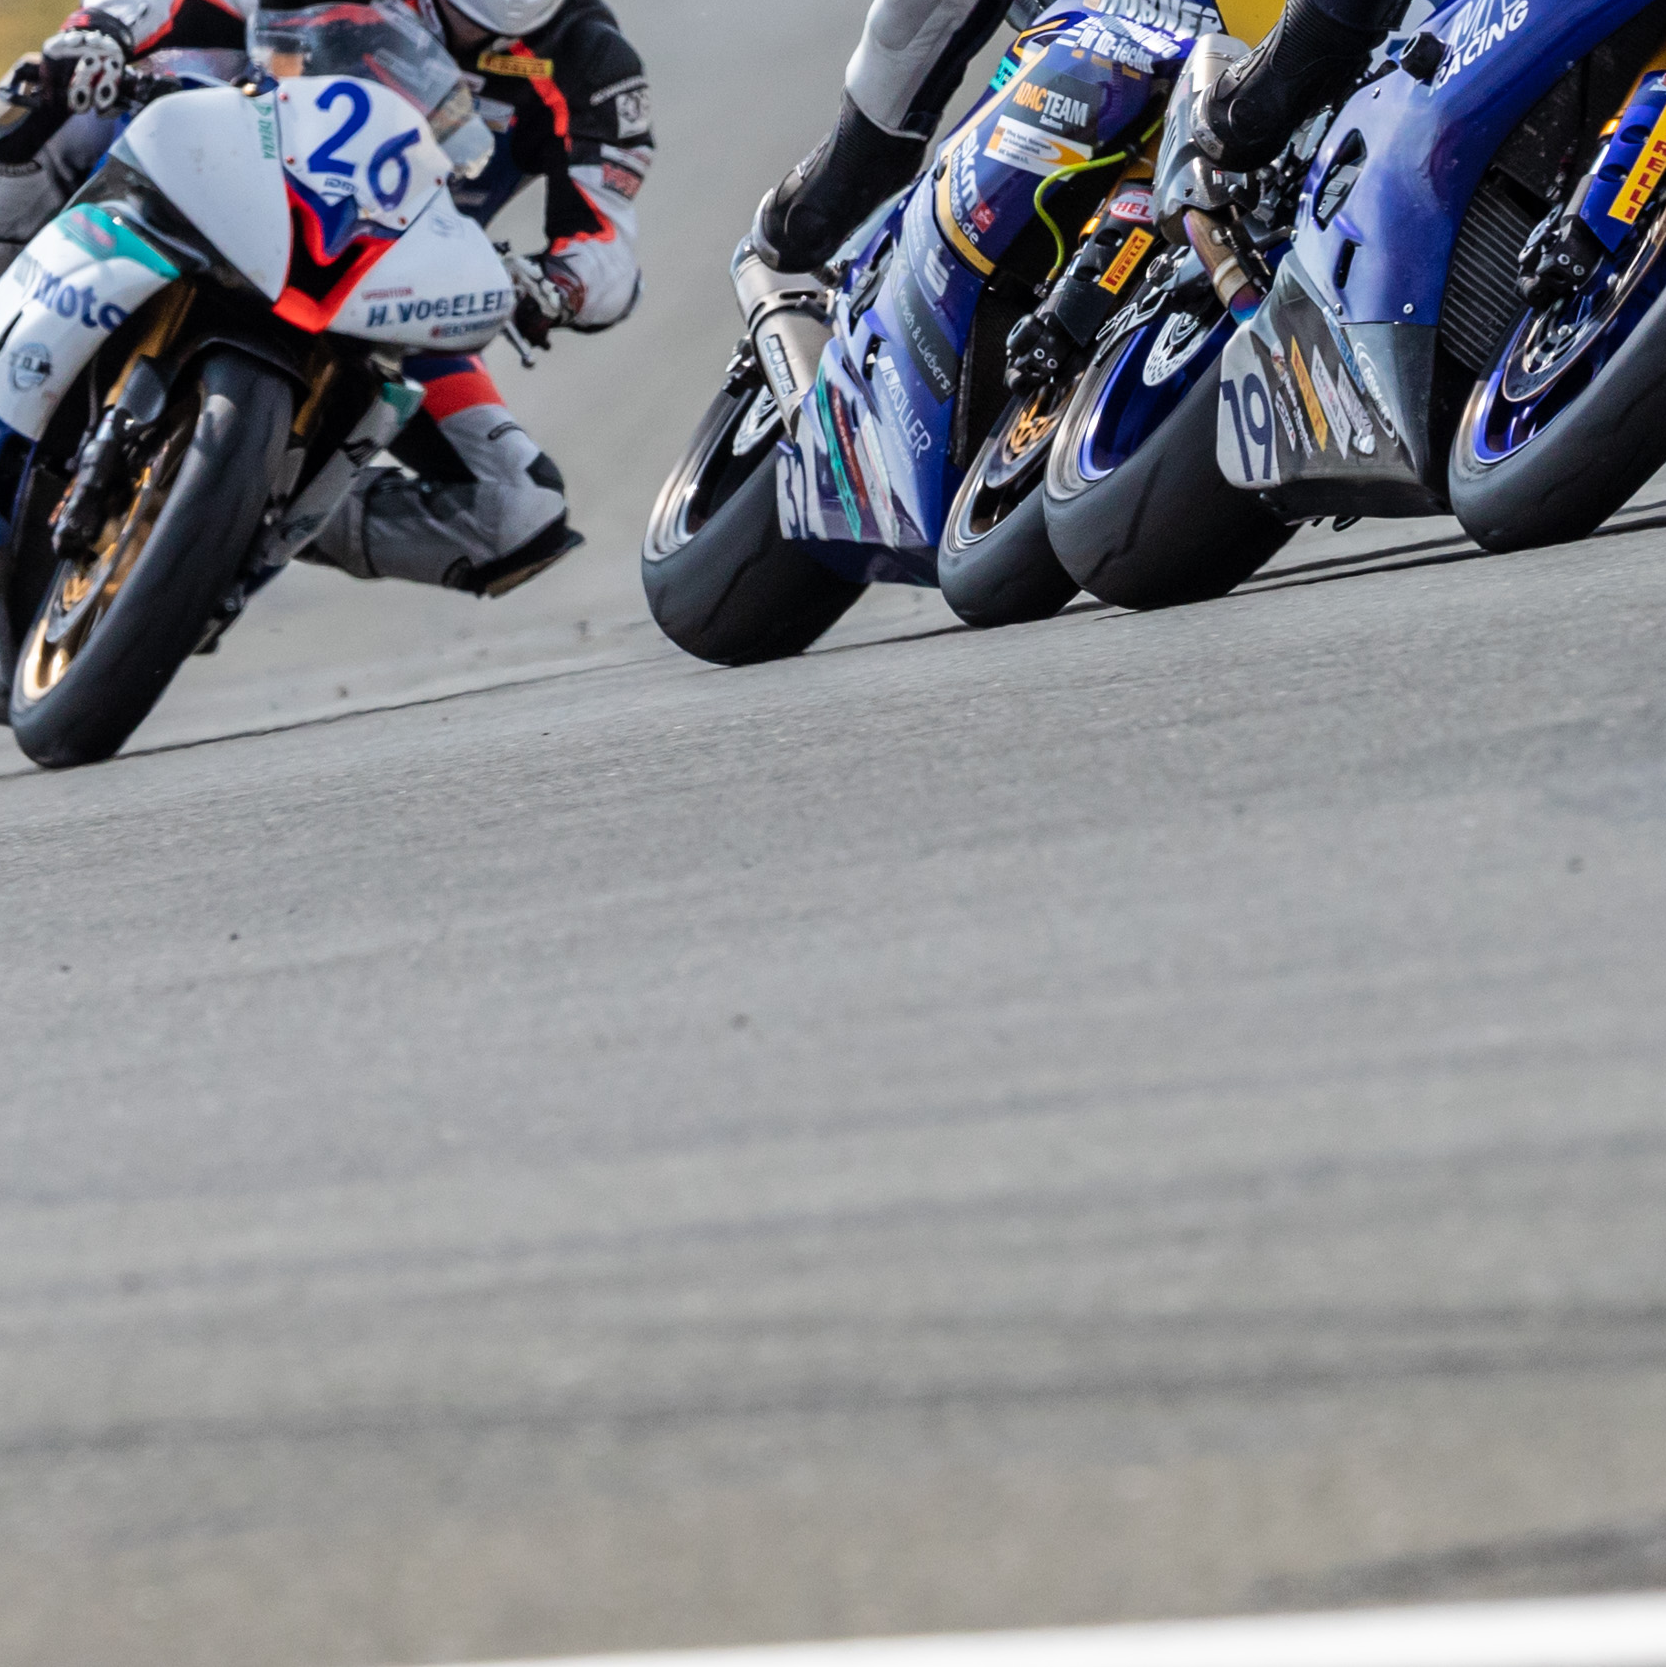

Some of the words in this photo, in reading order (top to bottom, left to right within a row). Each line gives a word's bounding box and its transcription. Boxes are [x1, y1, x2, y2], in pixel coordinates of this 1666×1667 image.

[306, 80, 422, 212] 26
[1104, 235, 1147, 288] PIRELLI
[1220, 372, 1274, 483] 19
